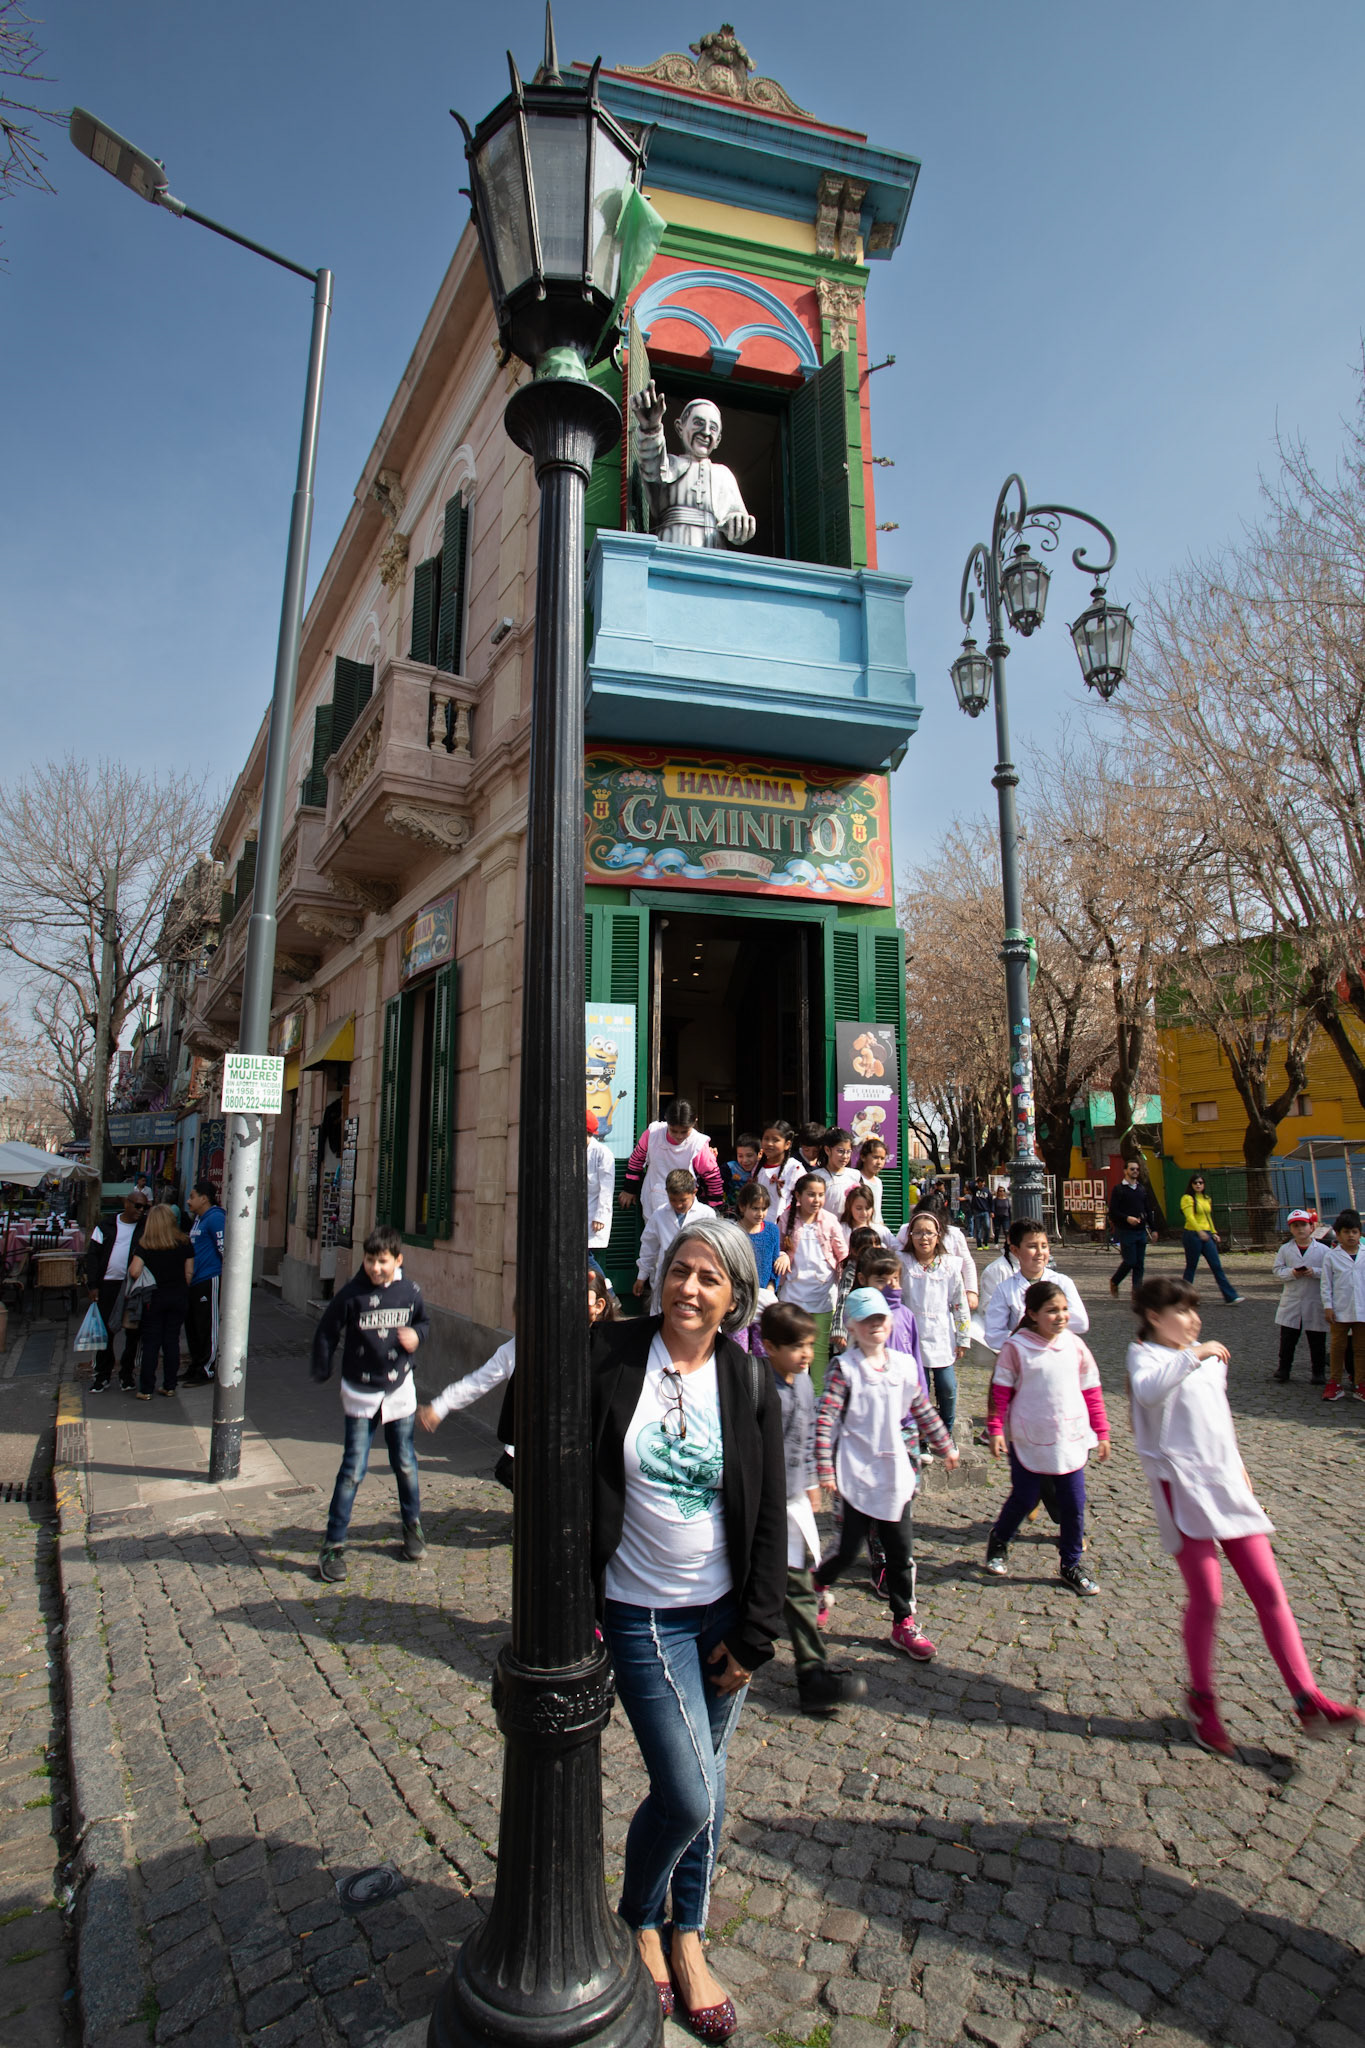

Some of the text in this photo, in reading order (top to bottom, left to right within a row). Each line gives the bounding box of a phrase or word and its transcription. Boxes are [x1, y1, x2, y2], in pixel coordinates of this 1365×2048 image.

[677, 770, 796, 804] HAVANNA
[620, 793, 846, 857] CAMINITO
[227, 1056, 282, 1071] JUBILESE
[230, 1070, 278, 1081] MUJERES
[225, 1095, 280, 1109] 0800-222-4444
